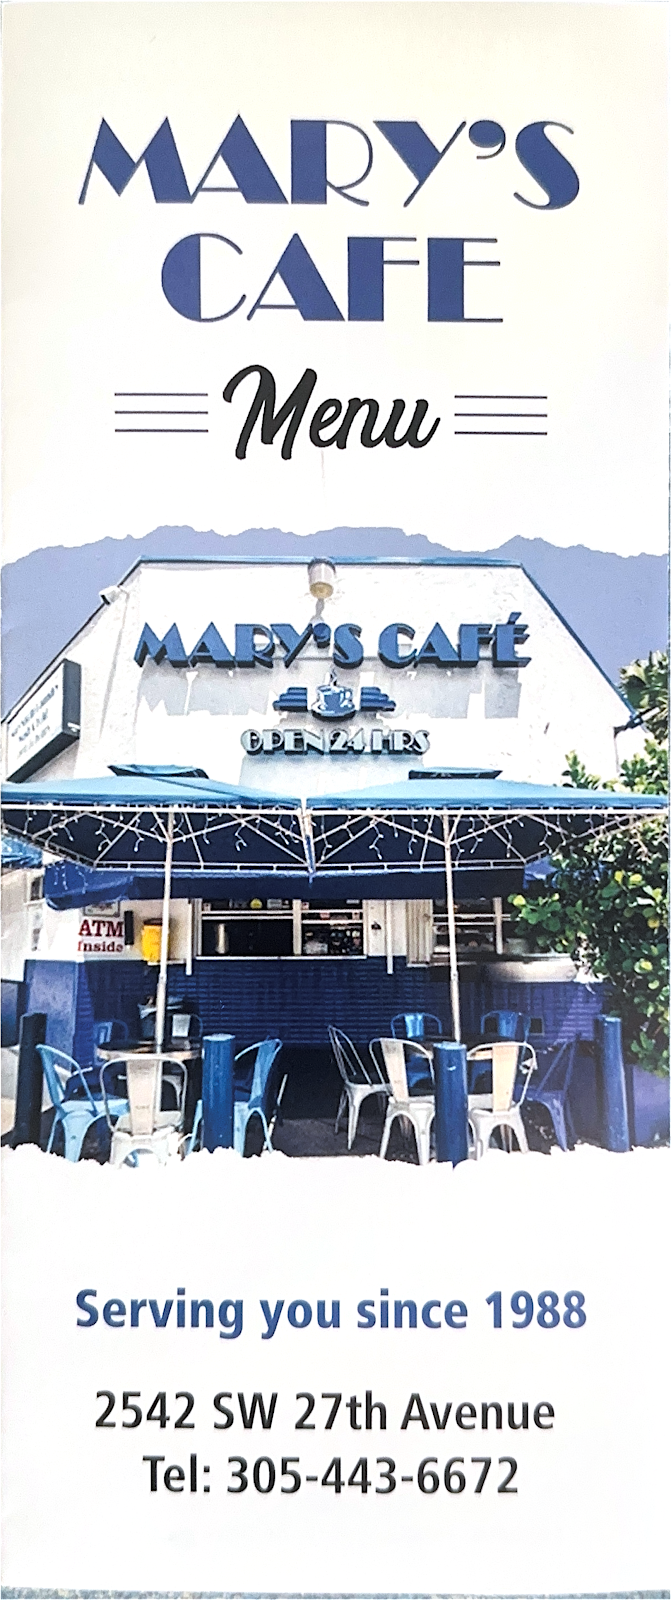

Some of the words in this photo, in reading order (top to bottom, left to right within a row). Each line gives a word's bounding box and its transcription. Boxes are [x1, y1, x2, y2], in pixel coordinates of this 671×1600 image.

[79, 114, 579, 210] MARY'S
[161, 233, 503, 322] CAFE
[223, 365, 440, 460] Menu
[133, 621, 364, 668] MARY'S
[378, 612, 532, 668] CAFÉ
[240, 728, 324, 756] OPEN
[329, 728, 367, 756] 24
[371, 728, 431, 756] HRS
[78, 941, 124, 952] Inside
[79, 919, 124, 937] ATM
[76, 1288, 243, 1339] Serving
[260, 1300, 340, 1339] you
[357, 1288, 467, 1328] since
[486, 1291, 586, 1328] 1988
[96, 1391, 195, 1428] 2542
[214, 1392, 278, 1429] SW
[295, 1391, 386, 1430] 27th
[401, 1393, 554, 1430] Avenue
[143, 1454, 210, 1492] Tel:
[227, 1456, 517, 1494] 305-443-6672
